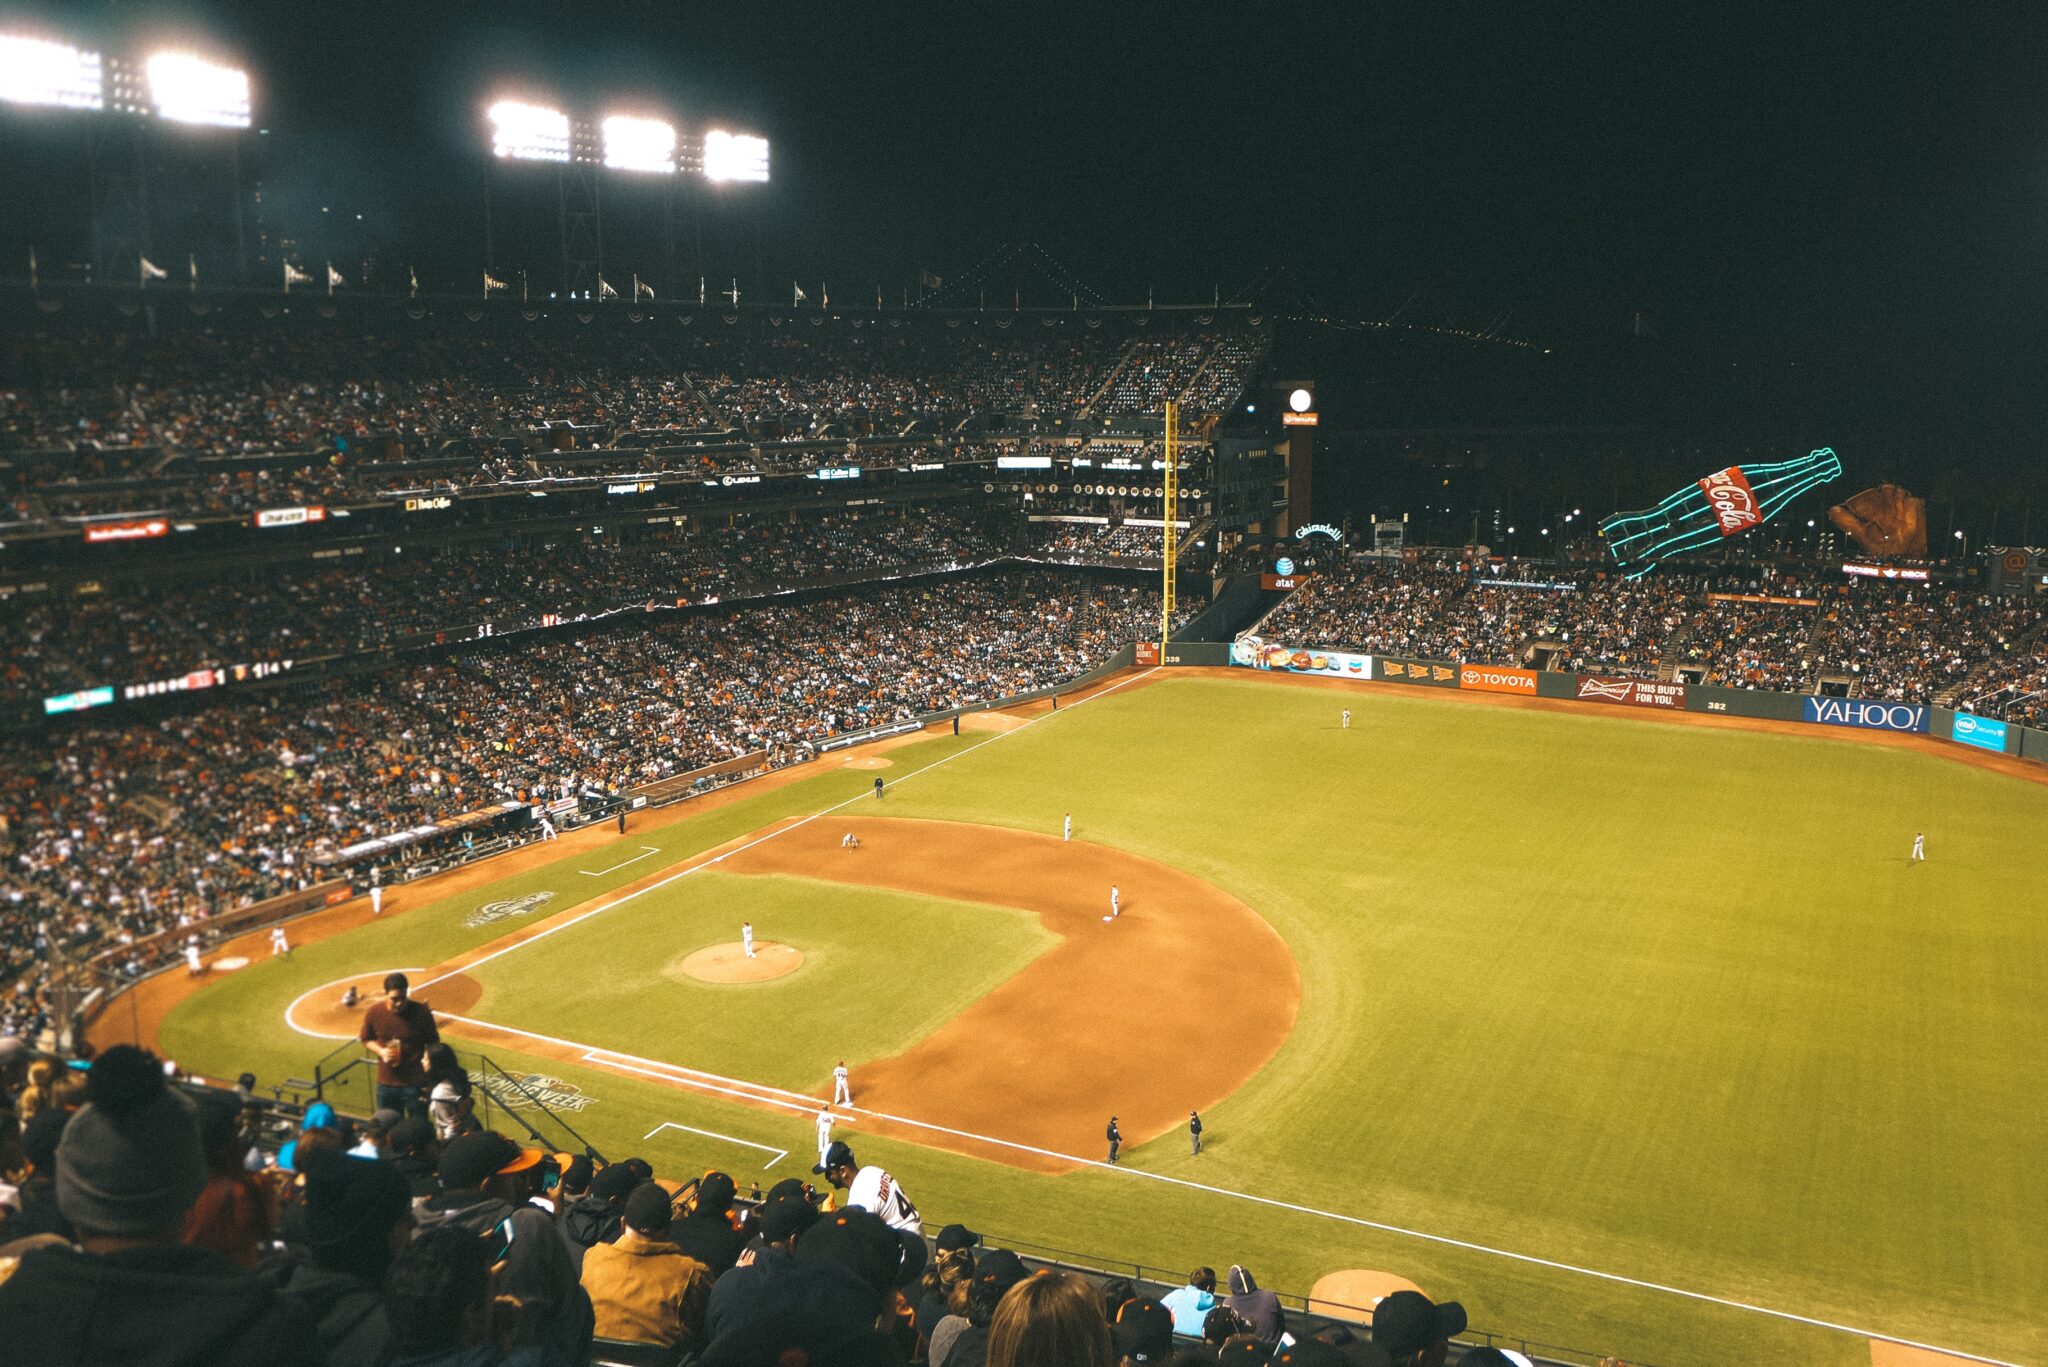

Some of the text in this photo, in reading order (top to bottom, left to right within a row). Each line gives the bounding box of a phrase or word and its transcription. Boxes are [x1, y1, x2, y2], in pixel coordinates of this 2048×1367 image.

[1295, 523, 1343, 541] Ghirardelli
[1275, 578, 1295, 589] at&t
[1482, 673, 1535, 688] TOYOTA
[1580, 682, 1631, 695] Budweiser
[1636, 683, 1684, 696] THIS BUD'S
[1635, 694, 1674, 705] FOR YOU.
[1707, 701, 1726, 710] 382
[1810, 697, 1924, 732] YAHOO!
[1958, 720, 1998, 737] intel Security
[537, 1085, 590, 1110] WEEK
